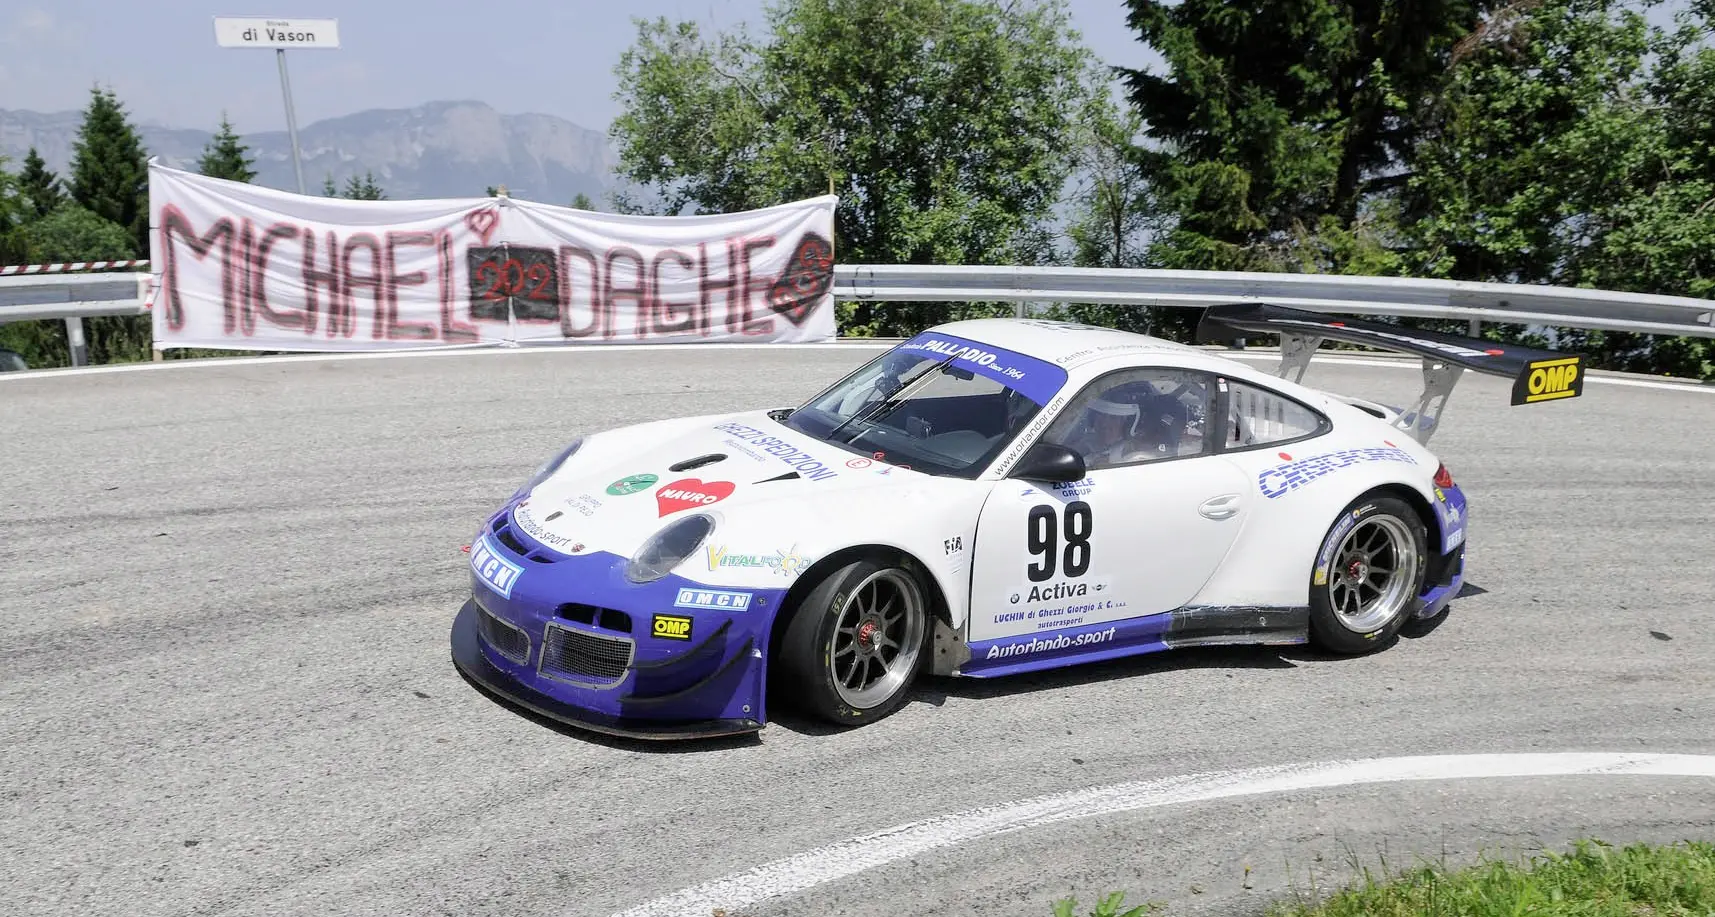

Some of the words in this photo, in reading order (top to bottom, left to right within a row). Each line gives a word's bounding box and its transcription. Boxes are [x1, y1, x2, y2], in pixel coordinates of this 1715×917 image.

[242, 28, 258, 41] di
[265, 28, 315, 41] Vason
[160, 203, 480, 344] MICHAEL
[476, 257, 552, 301] 202
[557, 235, 776, 339] DAGHE
[920, 339, 997, 366] PALLADIO
[1001, 366, 1026, 380] 1964
[1527, 364, 1578, 394] OMP
[994, 395, 1066, 476] www.orlandor.com
[751, 436, 839, 482] SPEDIZIONI
[658, 488, 718, 504] MAURO
[1061, 488, 1093, 498] GROUP
[1027, 500, 1093, 583] 98
[471, 539, 513, 588] OMCN
[680, 591, 748, 608] OMCN
[1026, 582, 1088, 603] Activa
[994, 611, 1026, 624] LUCHIN
[1027, 610, 1036, 619] di
[1038, 607, 1065, 618] Ghezzi
[1066, 603, 1096, 615] Giorgio
[1097, 602, 1104, 610] &
[1037, 616, 1084, 629] autotrasporti
[653, 619, 691, 635] OMP
[986, 626, 1117, 660] Autorlando-sport
